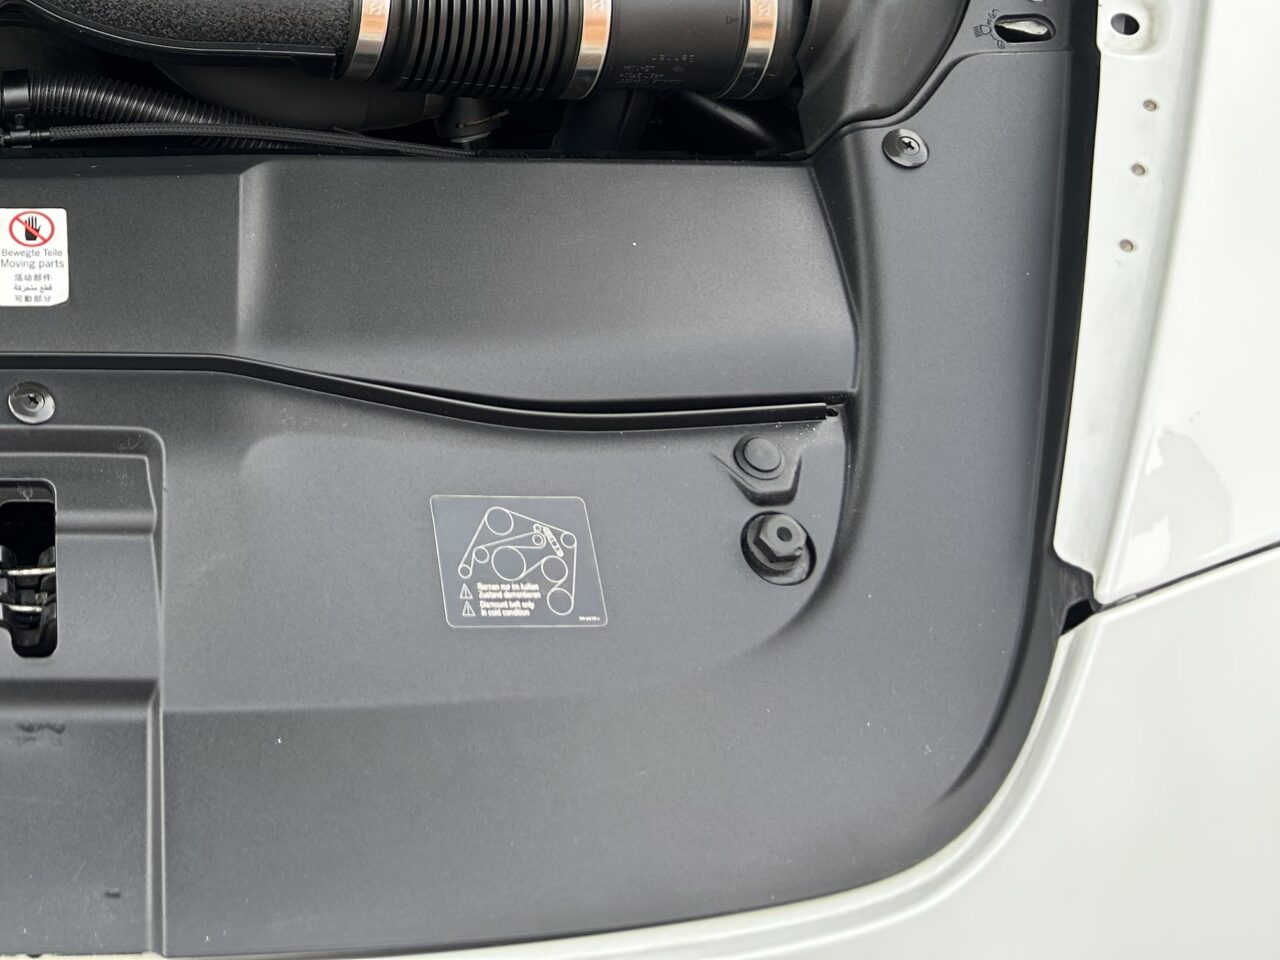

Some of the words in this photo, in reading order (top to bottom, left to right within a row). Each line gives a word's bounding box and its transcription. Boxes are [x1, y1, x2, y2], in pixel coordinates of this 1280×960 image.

[1, 248, 40, 258] Bewegte
[43, 248, 63, 257] Teile
[0, 259, 36, 269] Moving
[38, 259, 64, 269] parts
